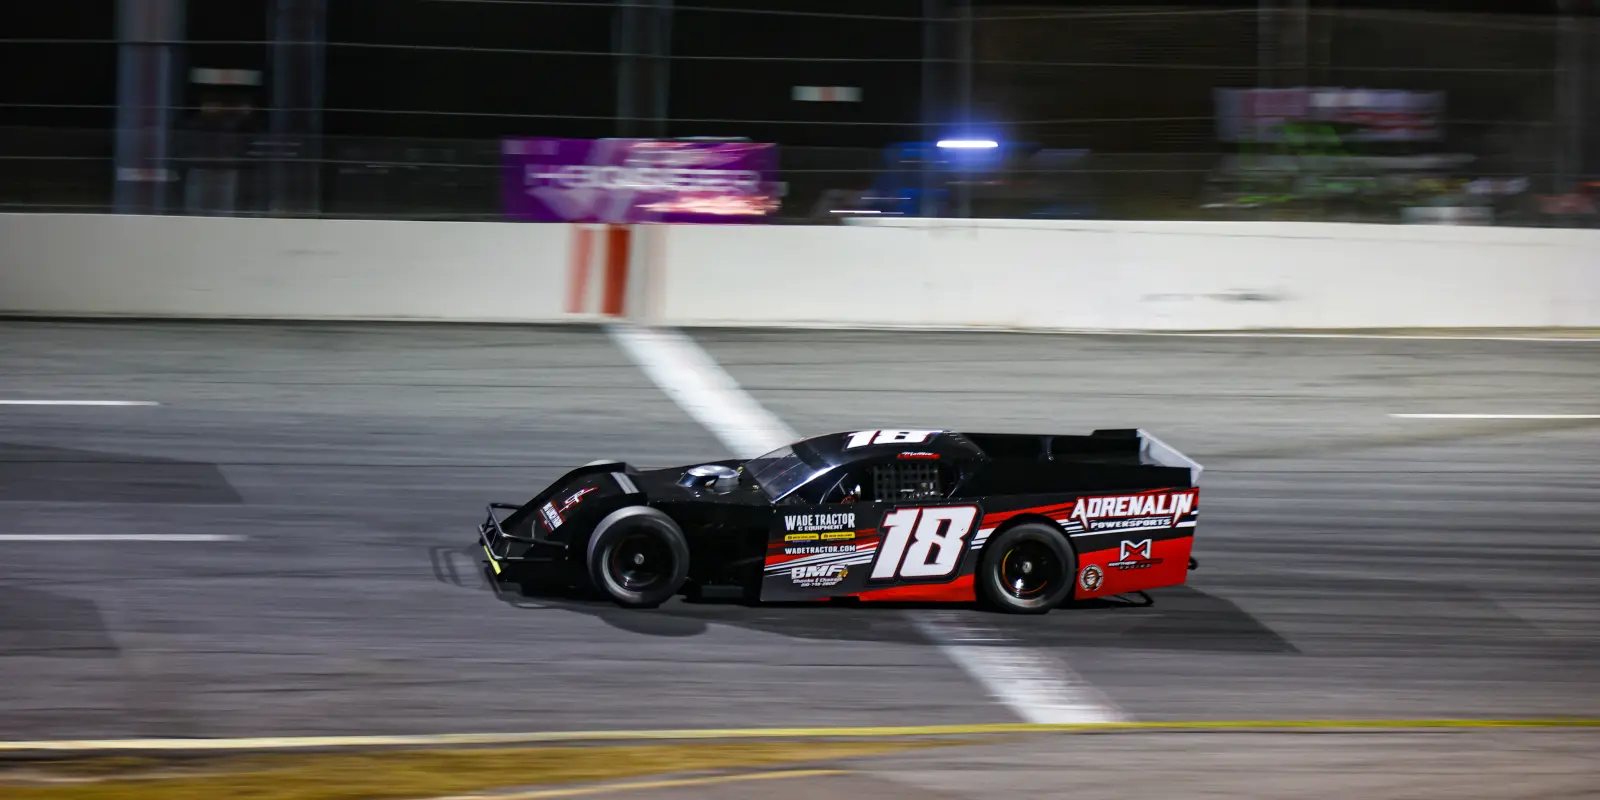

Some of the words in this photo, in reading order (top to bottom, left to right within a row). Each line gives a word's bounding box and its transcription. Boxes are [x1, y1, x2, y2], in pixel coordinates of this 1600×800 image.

[846, 429, 934, 449] 18
[784, 515, 813, 531] WADE
[814, 512, 856, 529] TRACTOR
[1070, 493, 1194, 531] ADRENALIN
[1090, 518, 1172, 529] POWERSPORTS
[784, 545, 856, 555] WADETRACTOR.COM
[870, 506, 978, 579] 18
[791, 565, 845, 579] BMF
